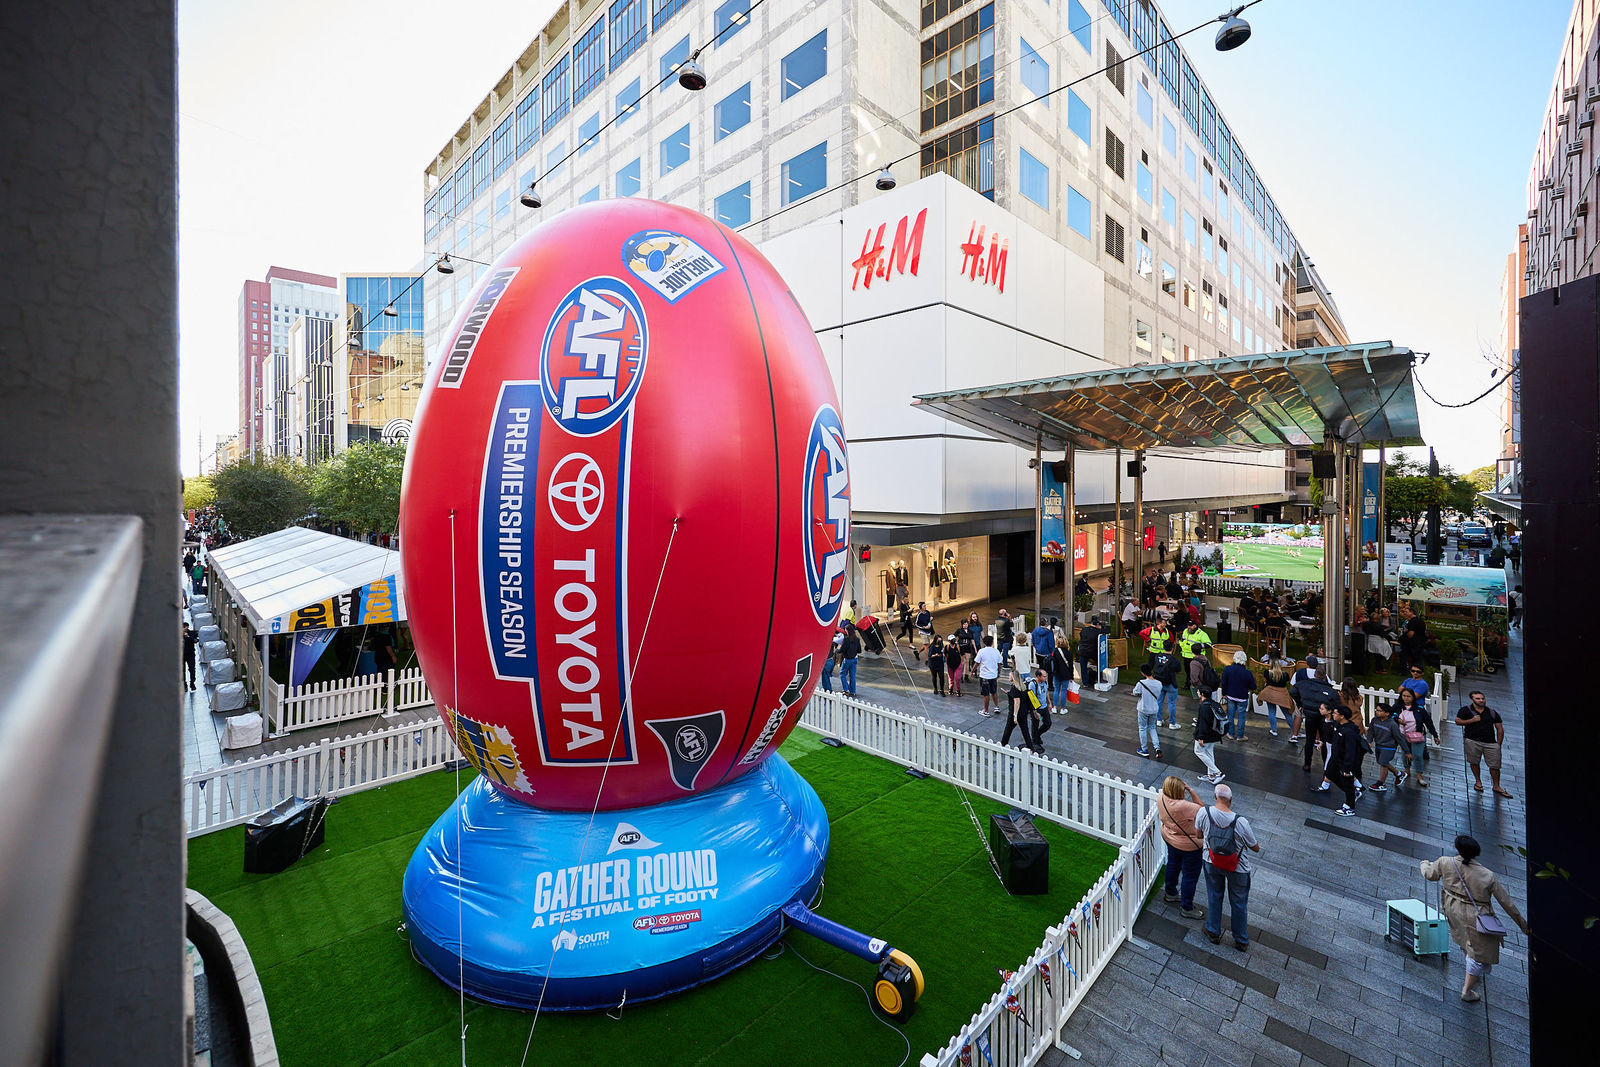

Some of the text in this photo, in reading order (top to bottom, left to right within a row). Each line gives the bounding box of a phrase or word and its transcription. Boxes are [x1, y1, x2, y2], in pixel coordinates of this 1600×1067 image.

[658, 255, 714, 294] ADELAIDE
[852, 208, 928, 291] H&M
[961, 219, 1009, 294] H&M
[442, 270, 515, 383] NORWOOD
[561, 287, 627, 421] AFL
[498, 407, 530, 660] PREMIERSHIP SEASON
[819, 422, 850, 609] AFL
[1074, 545, 1085, 559] ale
[1103, 540, 1112, 553] ale
[552, 549, 605, 752] TOYOTA
[679, 731, 703, 760] AFL
[620, 834, 638, 843] AFL
[533, 849, 718, 914] GATHER ROUND
[531, 888, 719, 929] A FESTIVAL OF FOOTY
[634, 911, 700, 930] AFL TOYOTA
[578, 930, 610, 945] SOUTH
